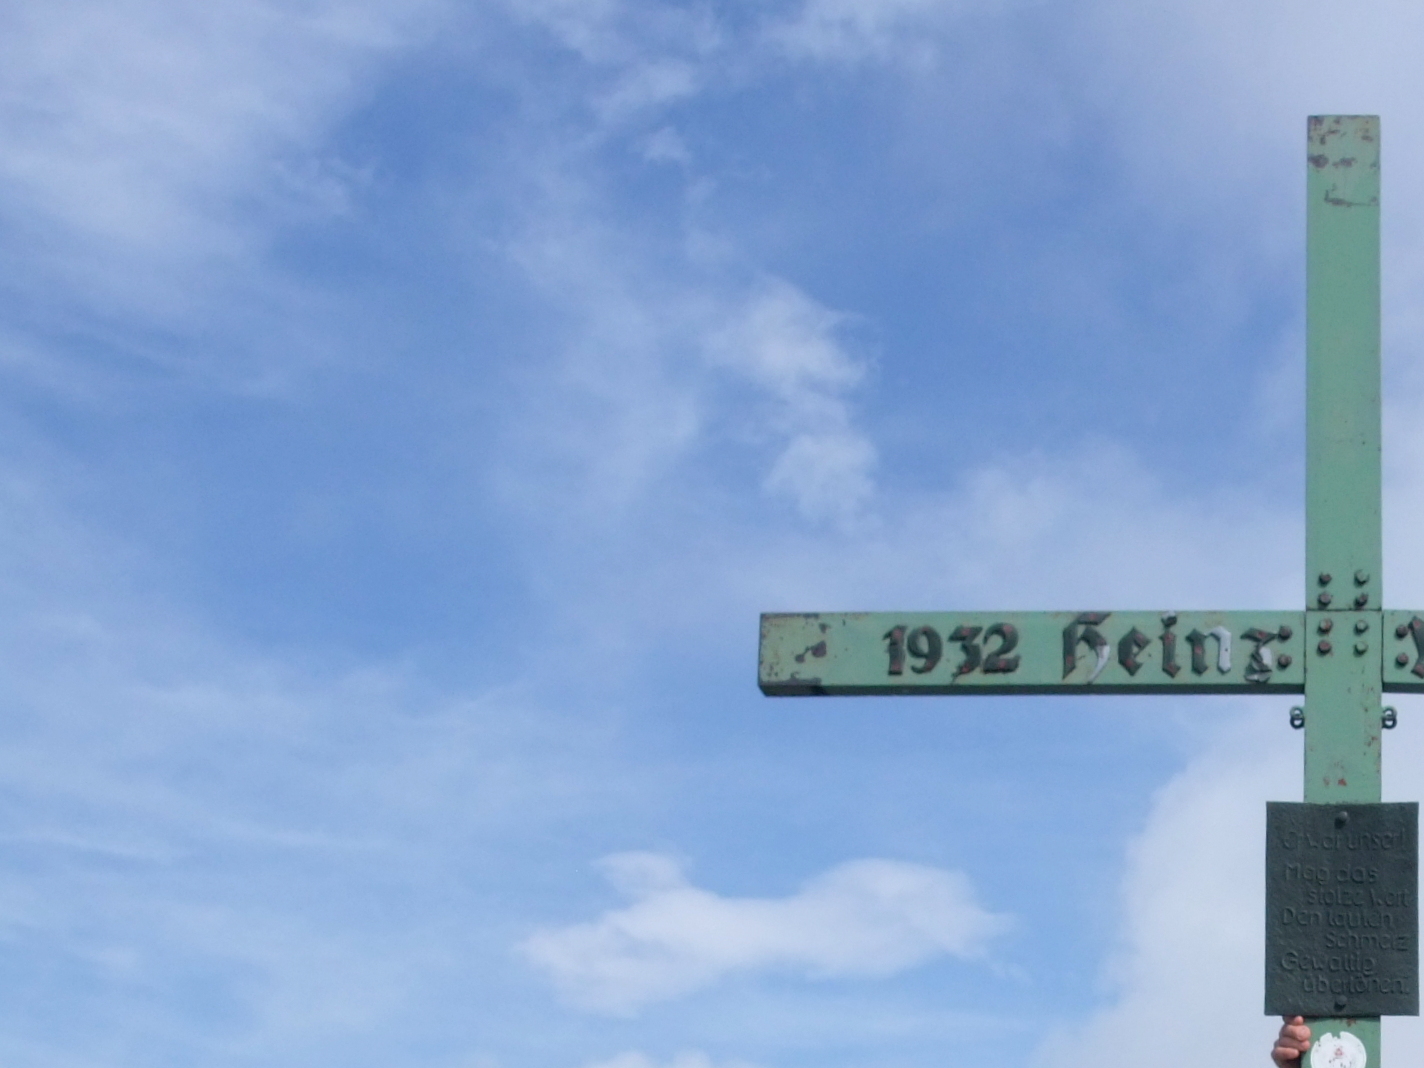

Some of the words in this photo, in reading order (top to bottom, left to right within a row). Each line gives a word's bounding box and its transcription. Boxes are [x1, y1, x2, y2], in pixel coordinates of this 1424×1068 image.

[883, 623, 1020, 682] 1932
[1285, 862, 1330, 885] Mag
[1336, 863, 1379, 884] das
[1307, 886, 1363, 906] stolze
[1281, 906, 1322, 926] Den
[1325, 929, 1409, 951] Schmerz
[1280, 951, 1376, 975] Gewaltig
